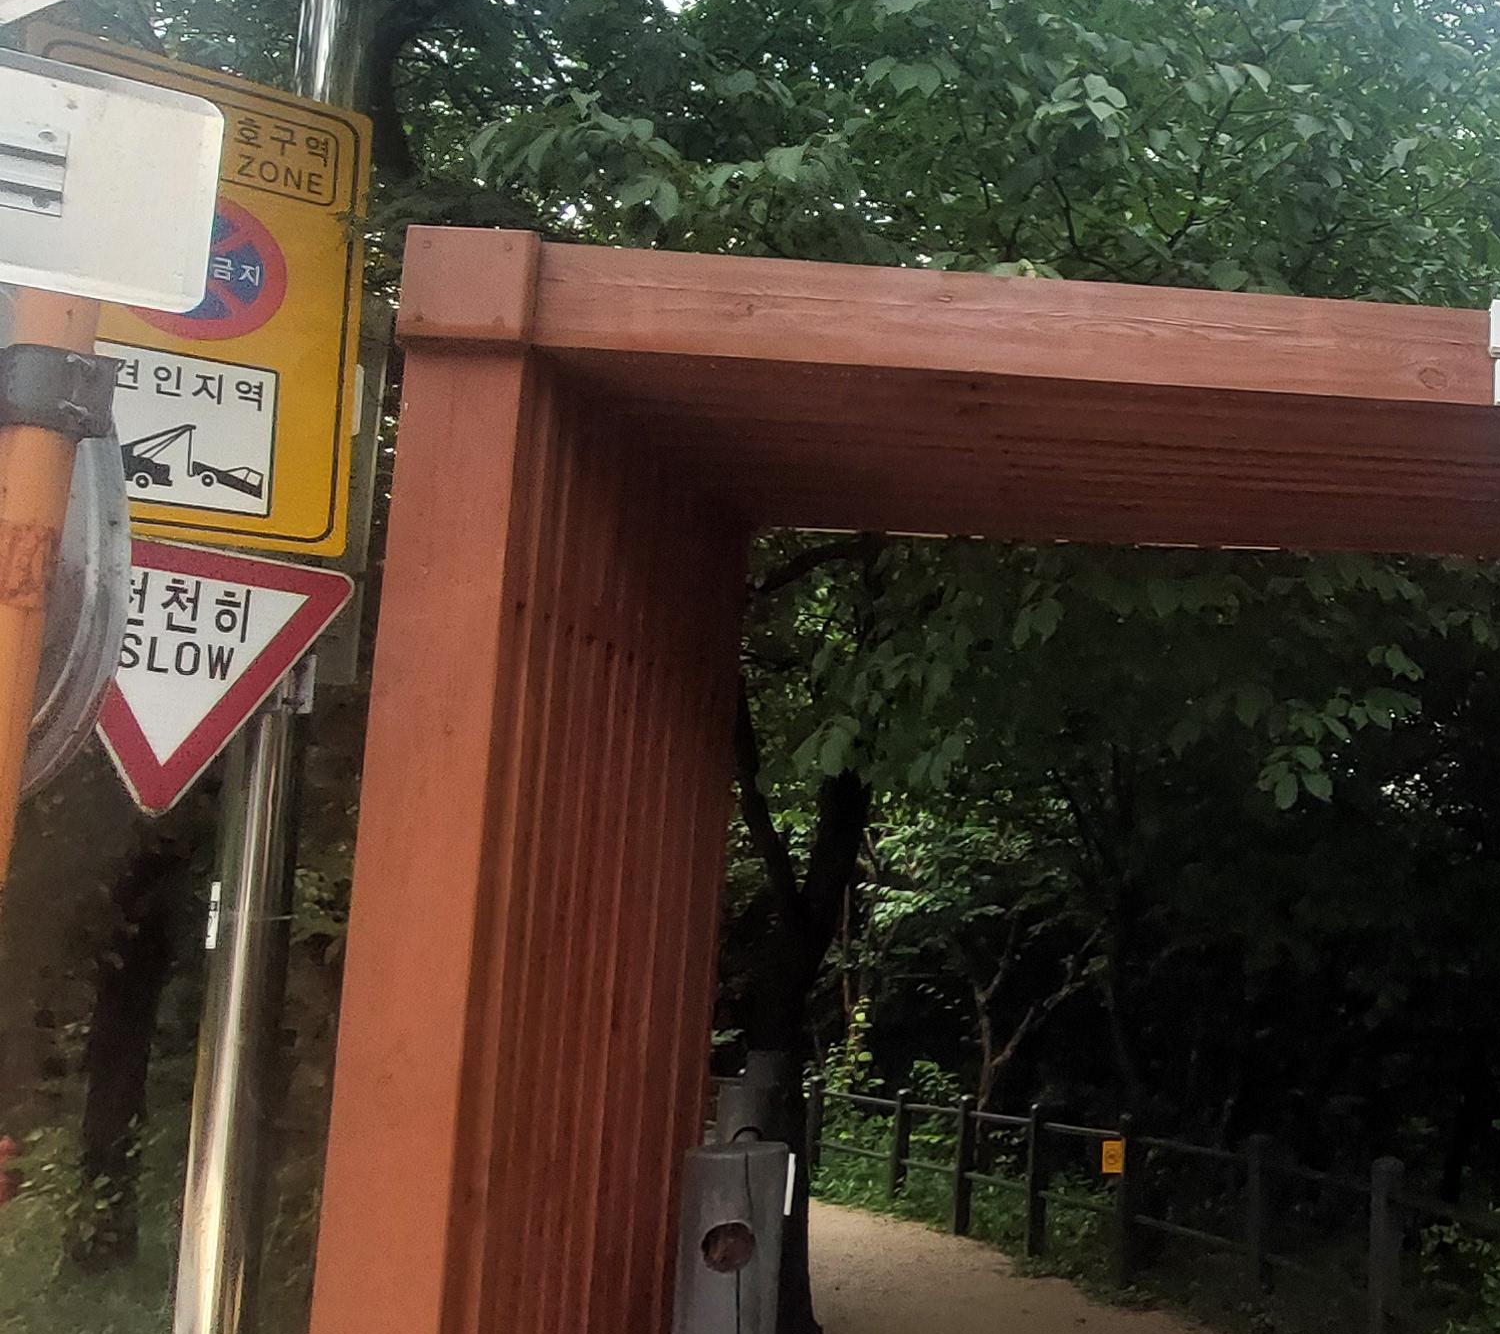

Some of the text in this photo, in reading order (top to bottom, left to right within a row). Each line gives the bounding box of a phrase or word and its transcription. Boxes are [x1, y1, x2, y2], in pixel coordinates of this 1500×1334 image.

[233, 117, 329, 167] 호구역
[237, 154, 323, 195] ZONE
[211, 257, 260, 286] 금지
[115, 359, 264, 411] 견인지역
[118, 633, 235, 681] SLOW
